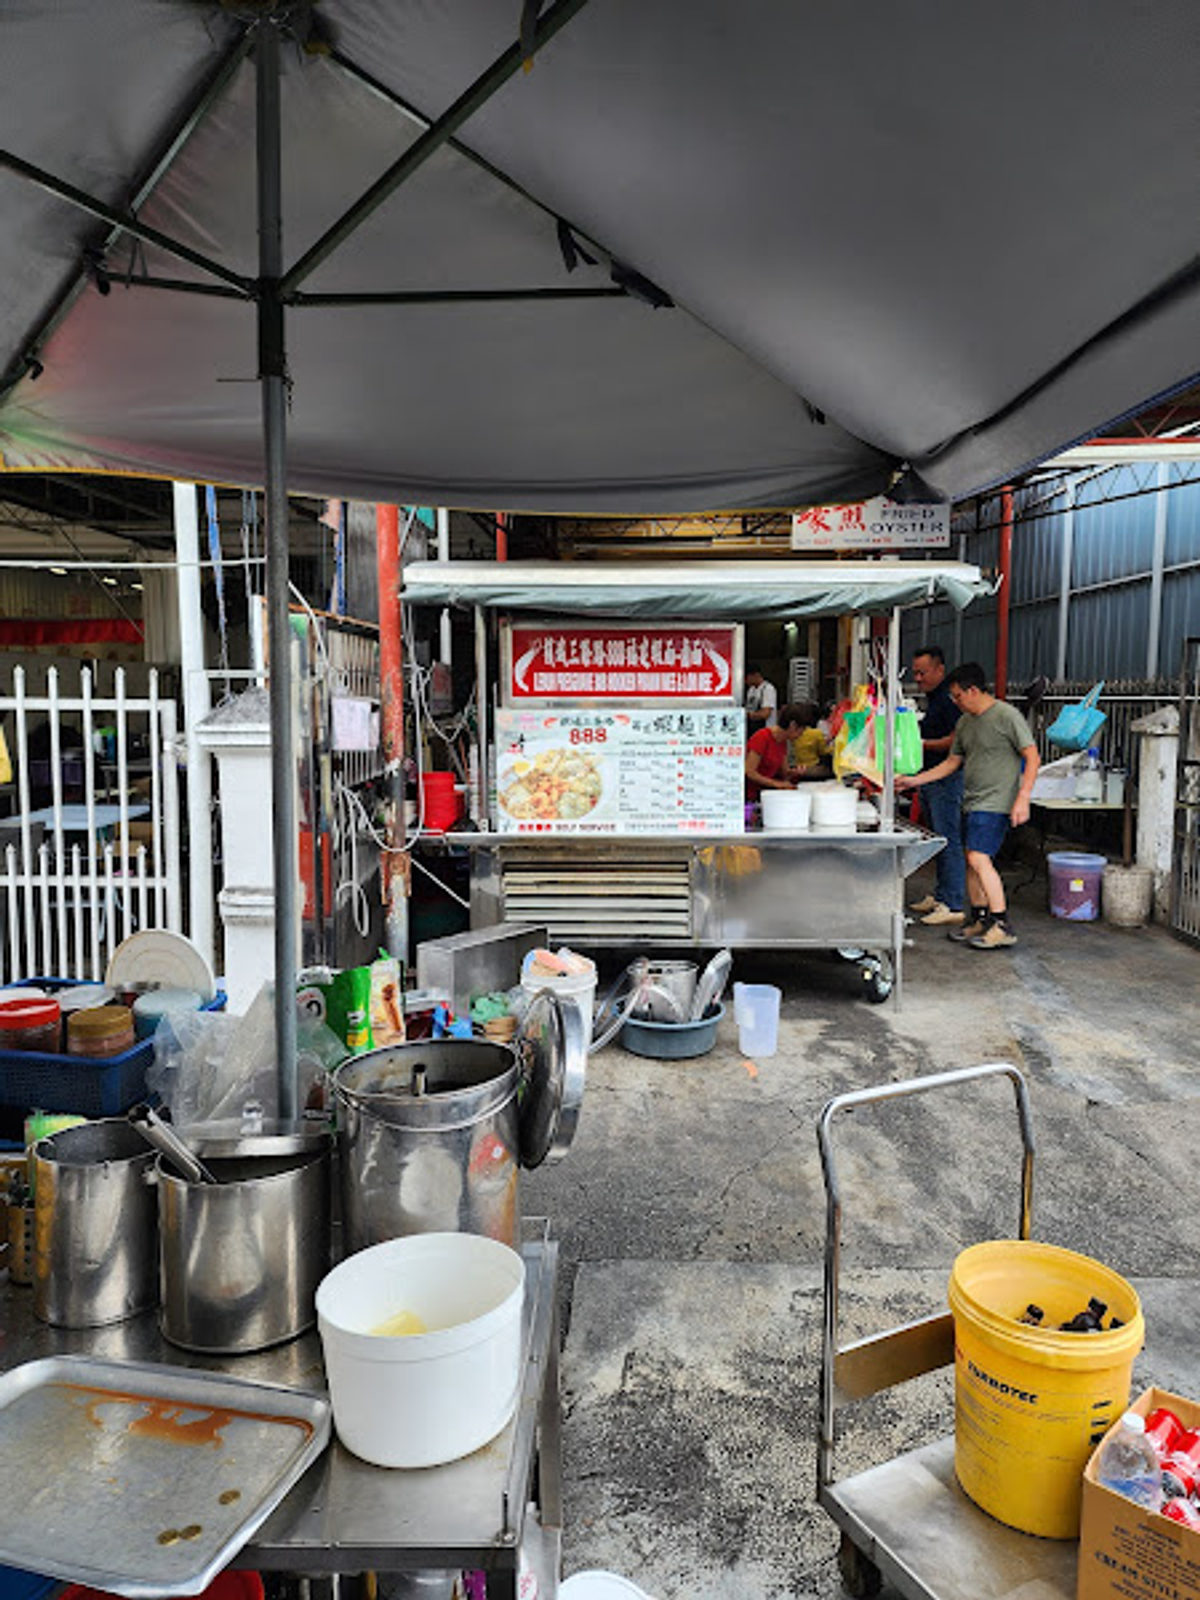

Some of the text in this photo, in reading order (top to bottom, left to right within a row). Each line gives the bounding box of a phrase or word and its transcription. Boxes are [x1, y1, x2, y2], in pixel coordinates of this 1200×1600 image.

[881, 509, 935, 520] FRIED
[870, 522, 944, 534] OYSTER
[569, 728, 607, 745] 888
[693, 746, 713, 757] RM
